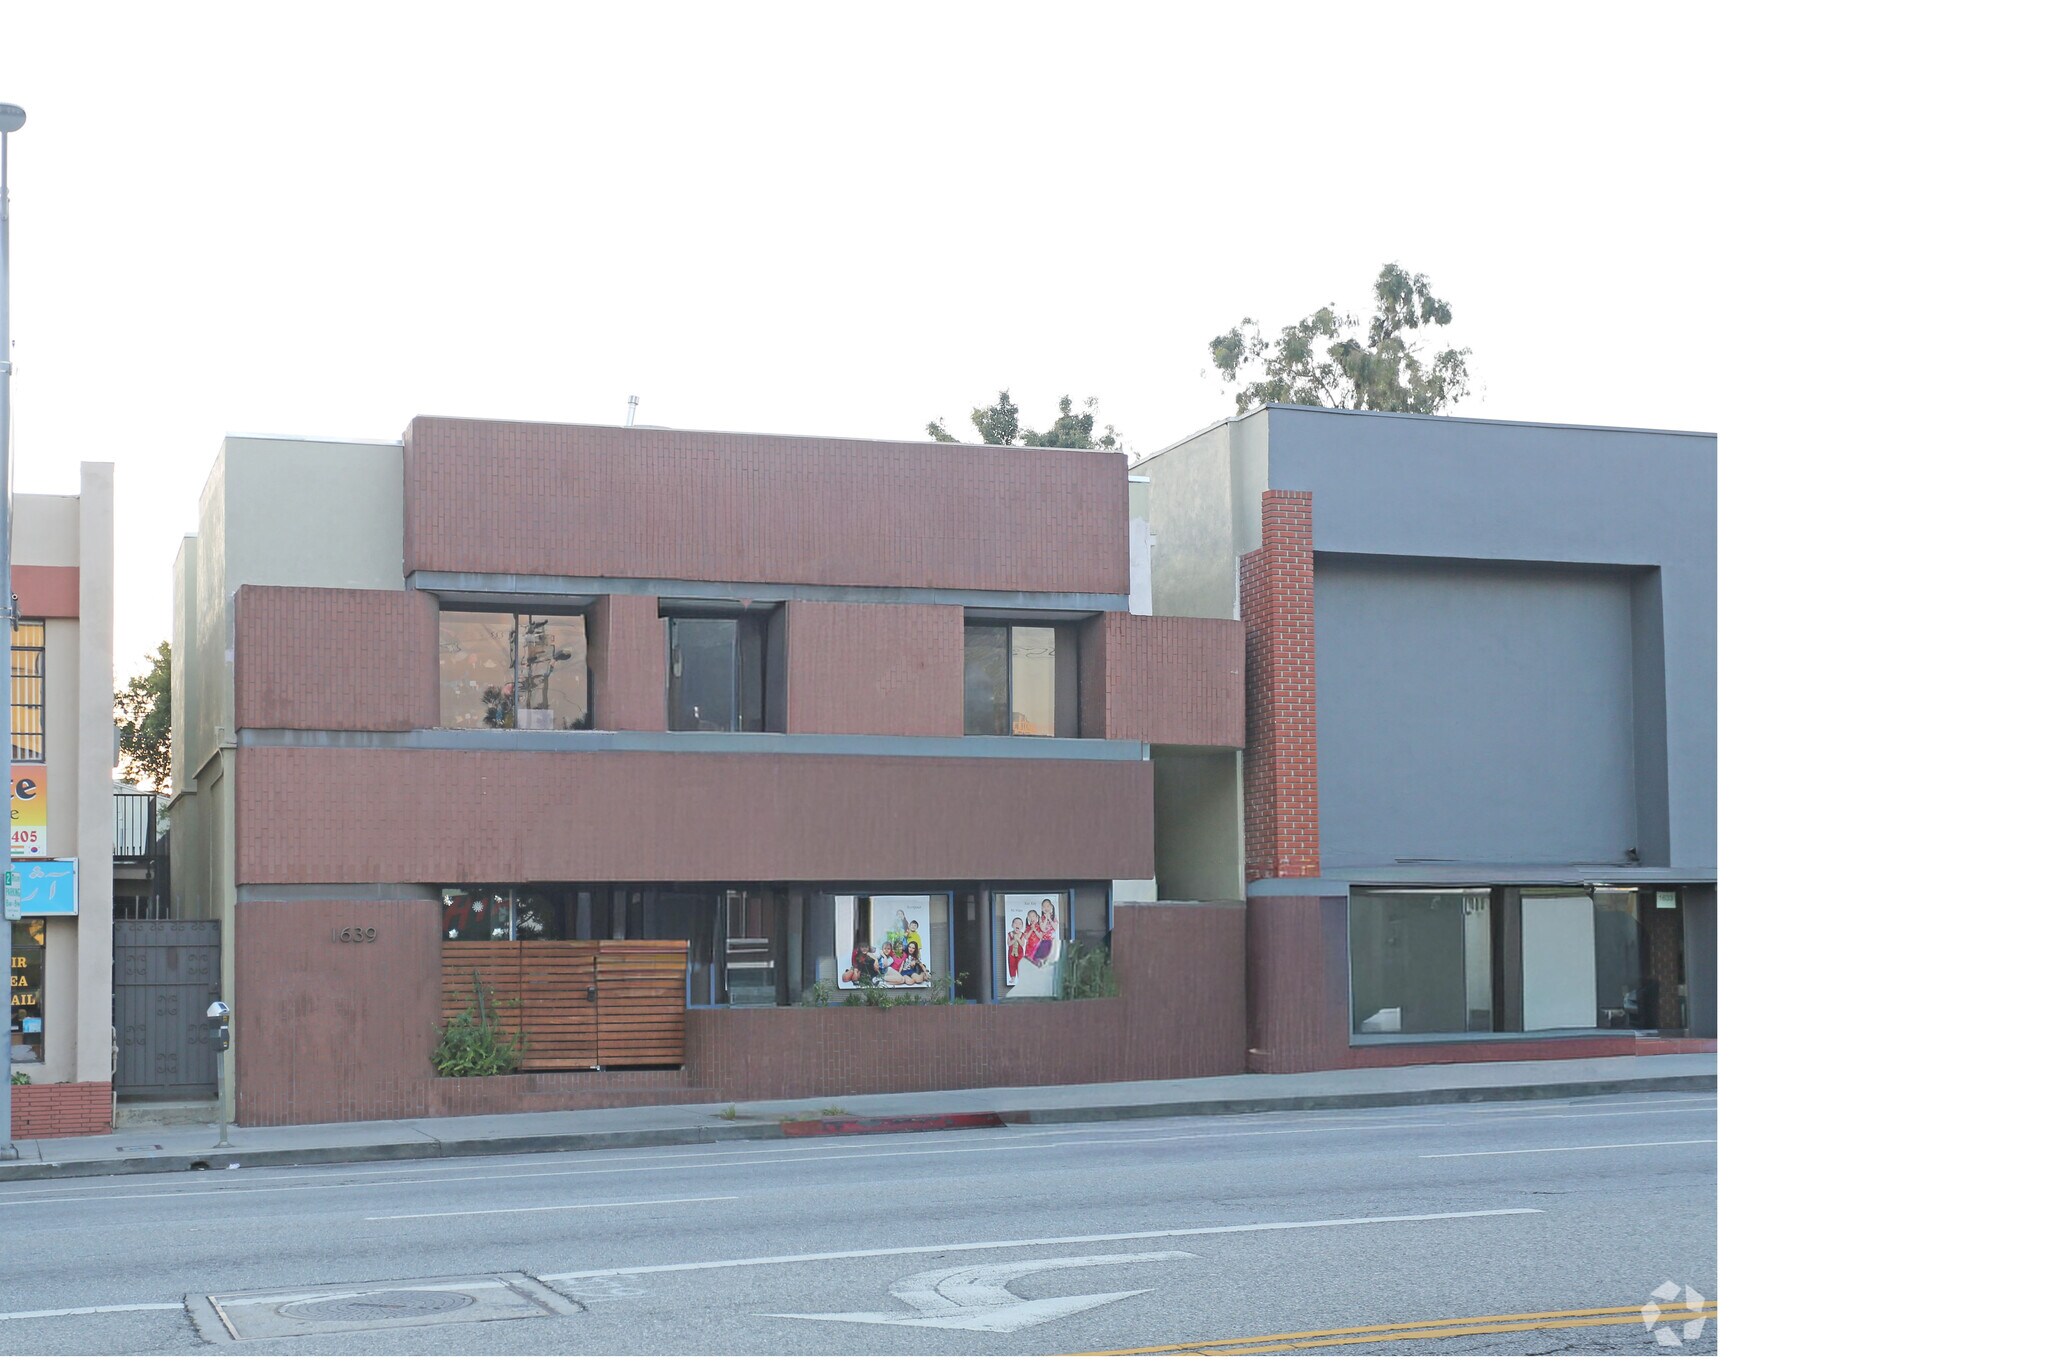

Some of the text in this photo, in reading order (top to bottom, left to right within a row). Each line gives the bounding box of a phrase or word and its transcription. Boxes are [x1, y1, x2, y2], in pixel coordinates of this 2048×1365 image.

[11, 778, 37, 801] e
[11, 830, 38, 843] 405
[332, 926, 377, 943] 1639
[10, 994, 36, 1006] AIL
